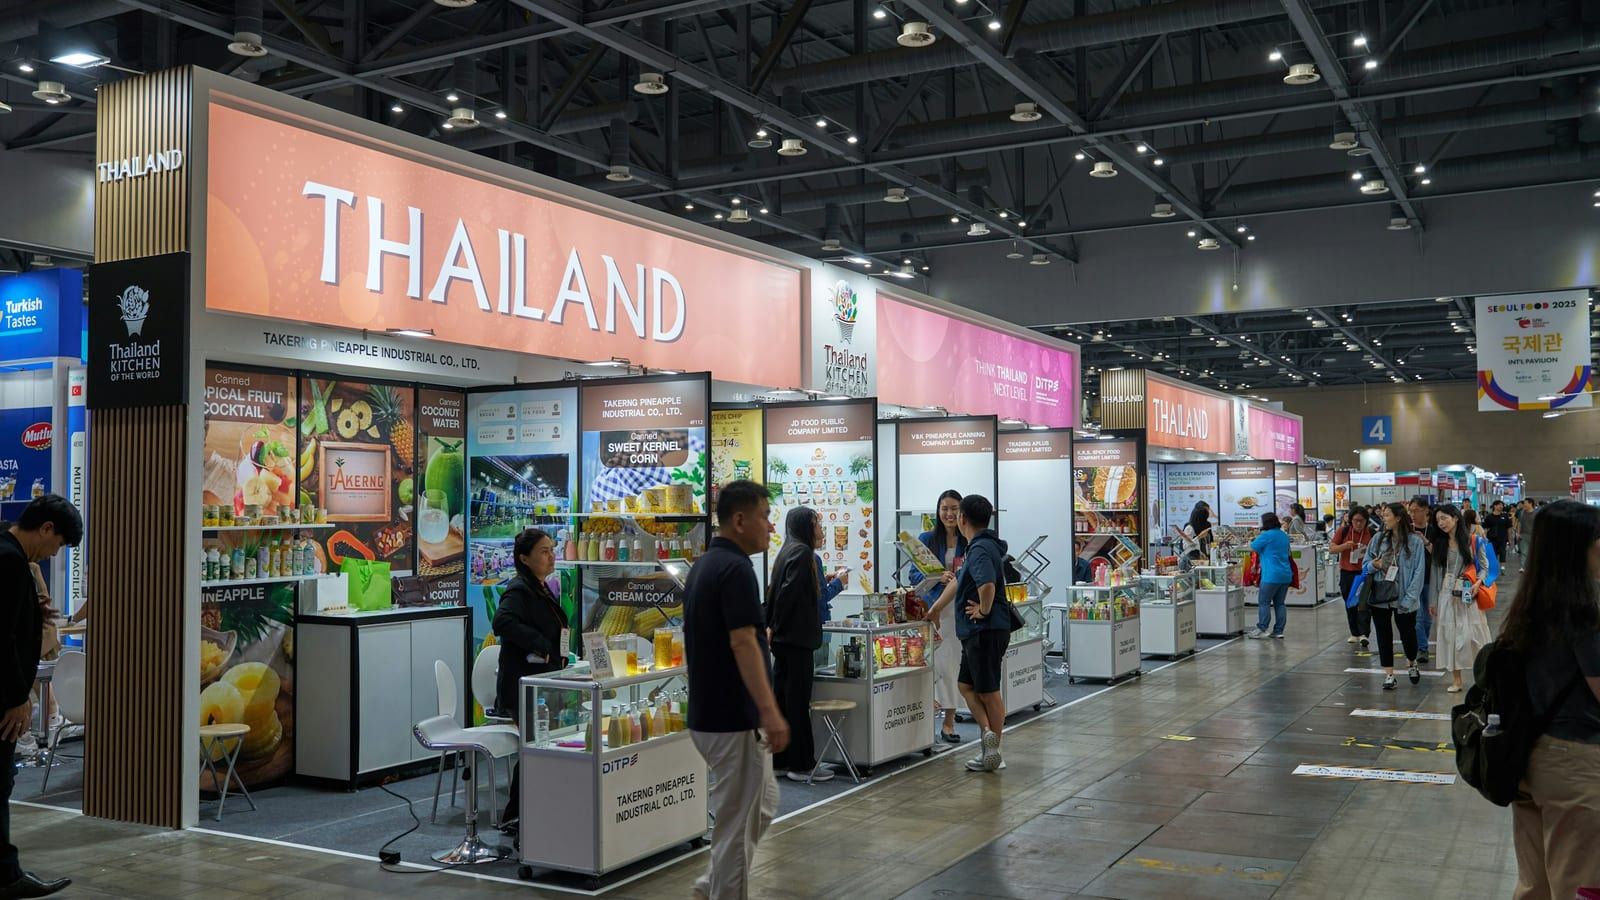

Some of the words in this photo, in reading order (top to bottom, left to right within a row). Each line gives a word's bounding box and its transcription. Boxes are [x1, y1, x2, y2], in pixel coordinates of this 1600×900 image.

[99, 149, 183, 183] THAILAND
[302, 180, 687, 343] THAILAND
[5, 297, 43, 314] Turkish
[1487, 304, 1518, 313] SEOUL
[1521, 302, 1549, 311] FOOD
[1552, 300, 1576, 309] 2025
[5, 315, 37, 329] Tastes
[109, 339, 160, 359] Thailand
[1503, 332, 1564, 354] 국제관
[320, 339, 378, 357] PNEAPPLE
[381, 347, 438, 364] INDUSTRIAL
[461, 357, 481, 370] LTD.
[824, 344, 867, 370] Thailand
[110, 357, 161, 373] KITCHEN
[975, 360, 996, 377] THINK
[996, 365, 1028, 384] THAILAND
[110, 373, 120, 382] OF
[121, 372, 135, 381] THE
[136, 370, 160, 380] WORLD
[214, 373, 250, 386] Canned
[825, 365, 868, 385] KITCHEN
[203, 386, 245, 401] PICAL
[247, 389, 283, 404] FRUIT
[993, 382, 1009, 397] NEXT
[439, 398, 460, 407] Canned
[603, 399, 638, 408] TAKERNG
[639, 396, 682, 406] PINEAPPLE
[1101, 394, 1143, 404] THAILAND
[203, 402, 265, 418] COCKTAIL
[421, 406, 460, 418] COCONUT
[602, 409, 646, 418] INDUSTRIAL
[665, 407, 683, 416] LTD.
[432, 418, 460, 429] WATER
[1152, 398, 1208, 440] THAILAND
[630, 432, 658, 440] Canned
[787, 428, 820, 436] COMPANY
[821, 426, 848, 434] LIMITED
[1369, 420, 1386, 441] 4
[607, 442, 641, 453] SWEET
[642, 441, 682, 452] KERNEL
[0, 459, 19, 470] ASTA
[629, 454, 658, 464] CORN
[328, 468, 384, 489] TAKERNG
[1073, 469, 1083, 478] RS
[73, 466, 81, 507] MUTLU
[72, 545, 81, 599] RNACILIK
[437, 580, 460, 588] Canned
[627, 581, 655, 591] Canned
[202, 587, 265, 603] INEAPPLE
[429, 589, 460, 600] CONUT
[607, 591, 643, 602] CREAM
[617, 786, 653, 807] TAKERNG
[655, 773, 695, 794] PINEAPPLE
[615, 801, 661, 823] INDUSTRIAL
[680, 789, 696, 801] LTD.
